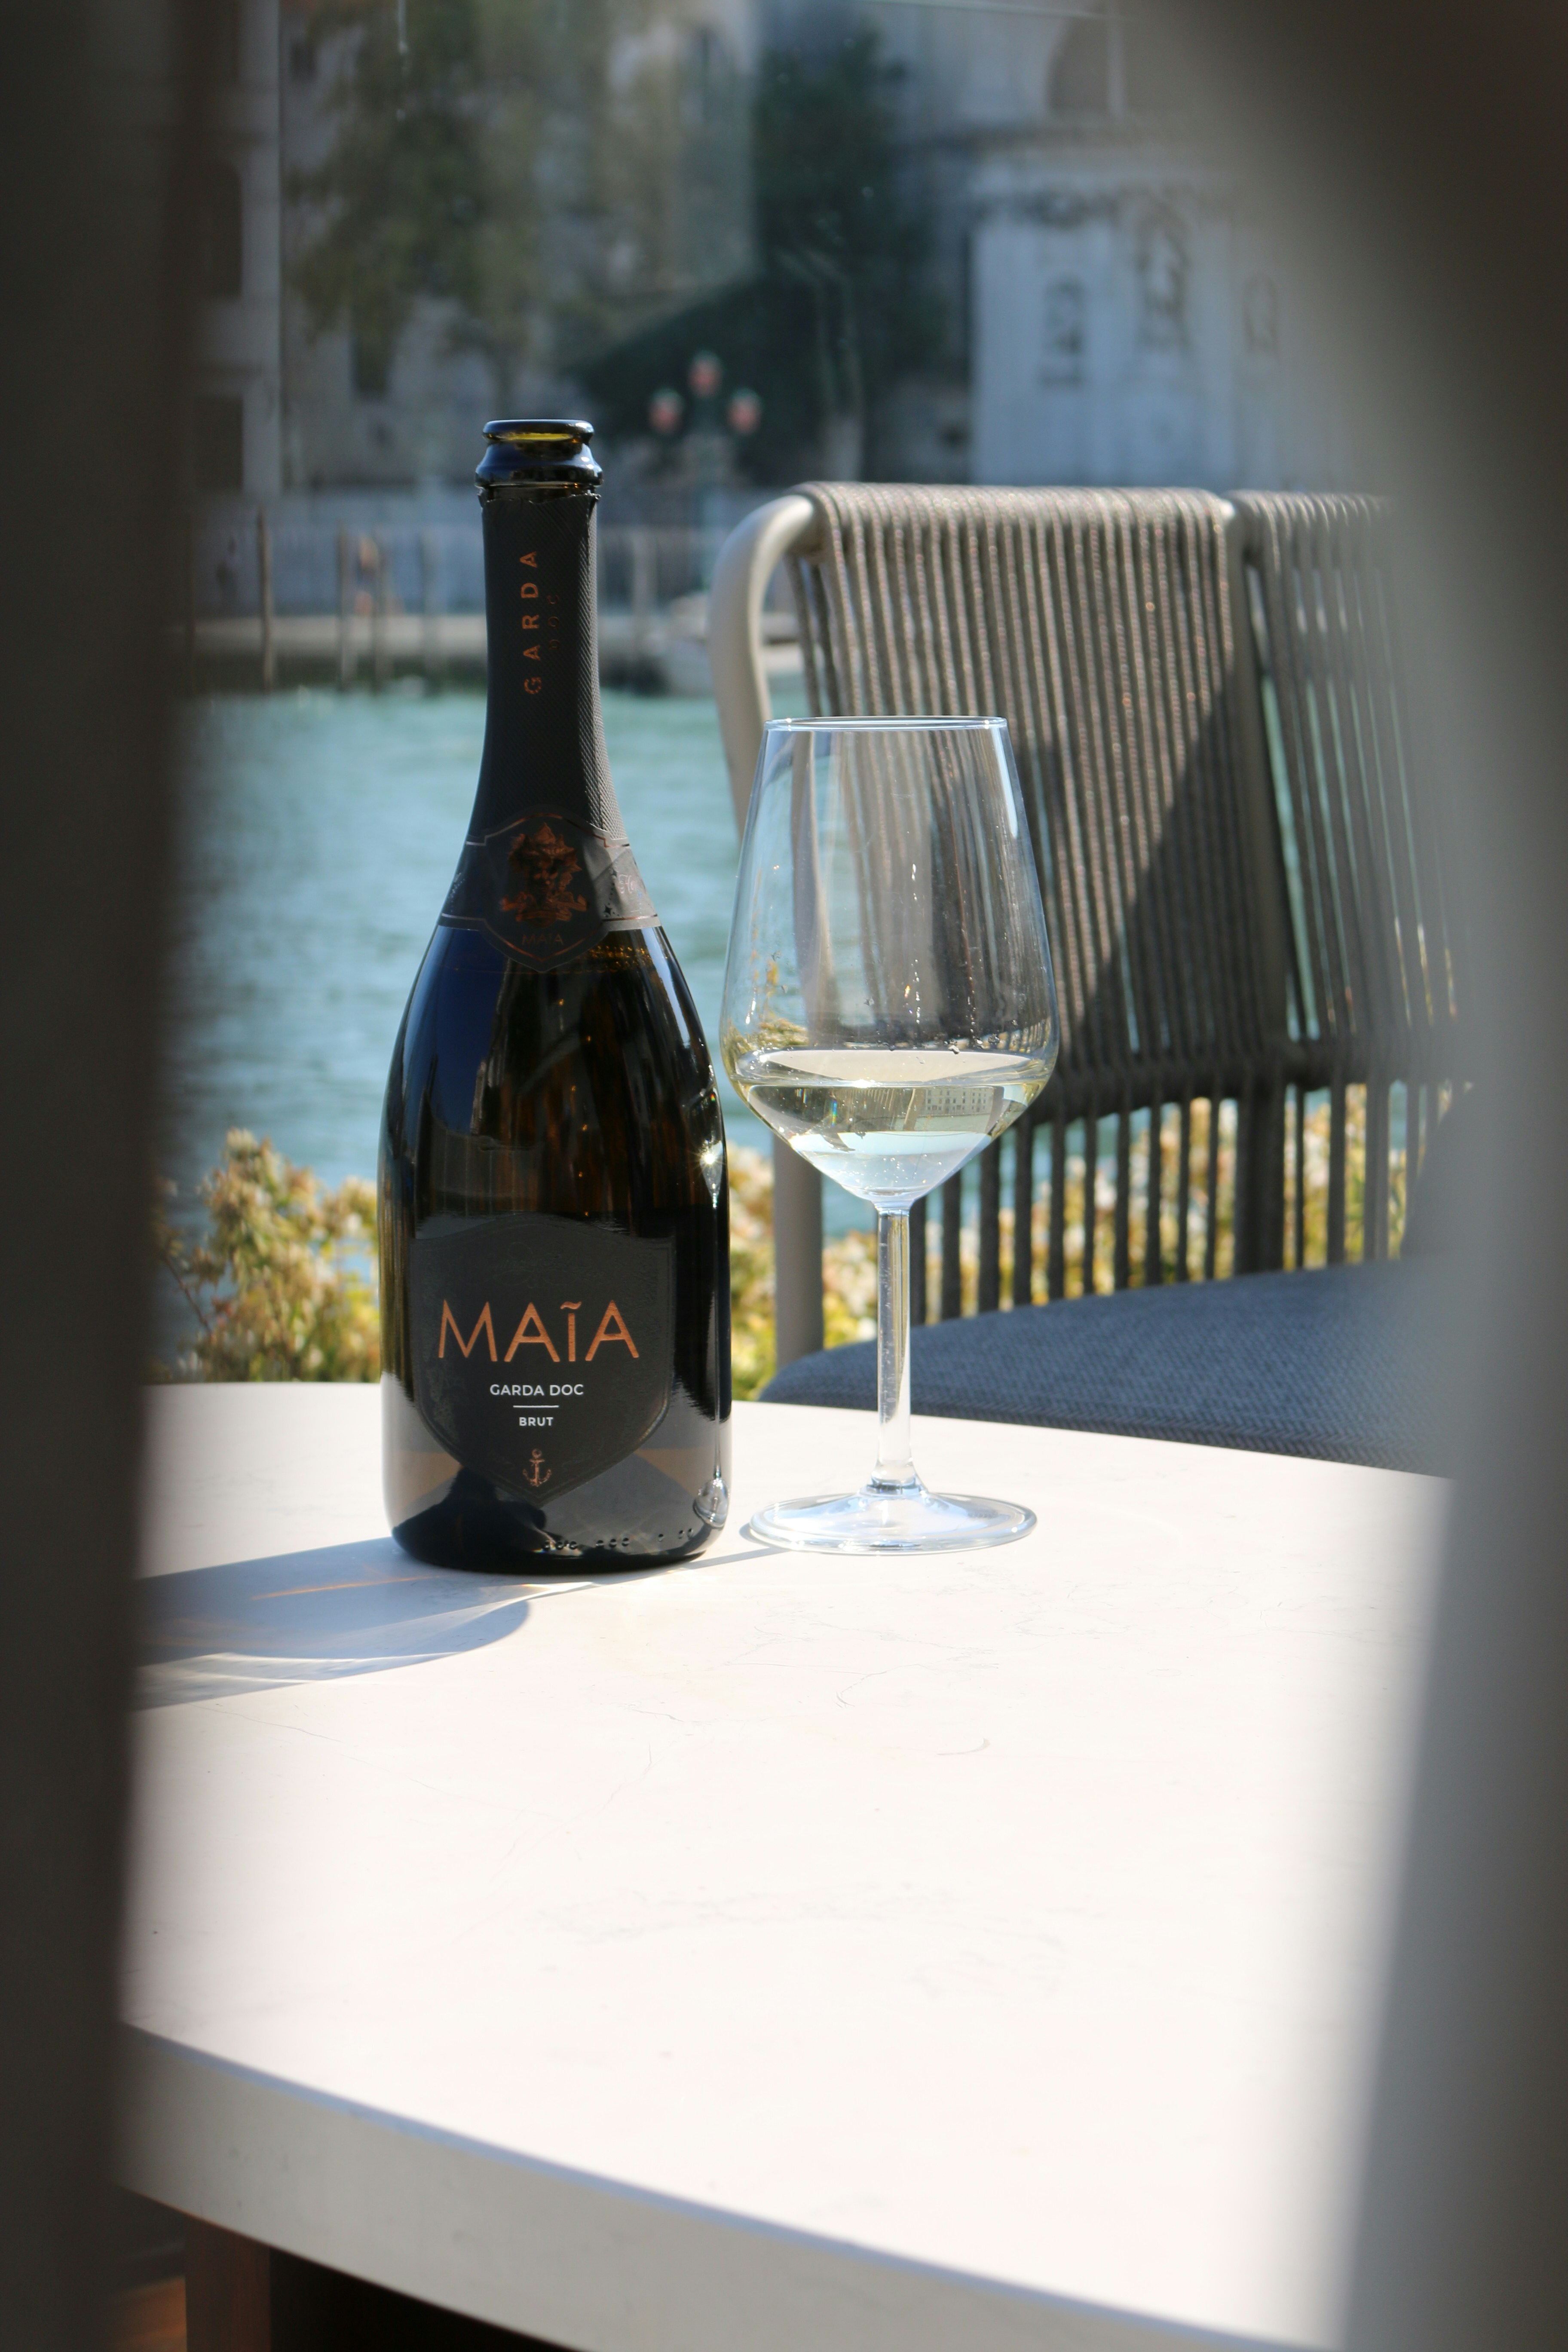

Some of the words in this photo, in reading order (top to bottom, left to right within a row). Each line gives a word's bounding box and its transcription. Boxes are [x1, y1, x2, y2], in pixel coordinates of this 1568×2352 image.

[520, 551, 542, 694] GARDA
[547, 594, 560, 650] DOC
[490, 1384, 545, 1396] GARDA
[549, 1384, 584, 1396] DOC
[519, 1417, 554, 1427] BRUT
